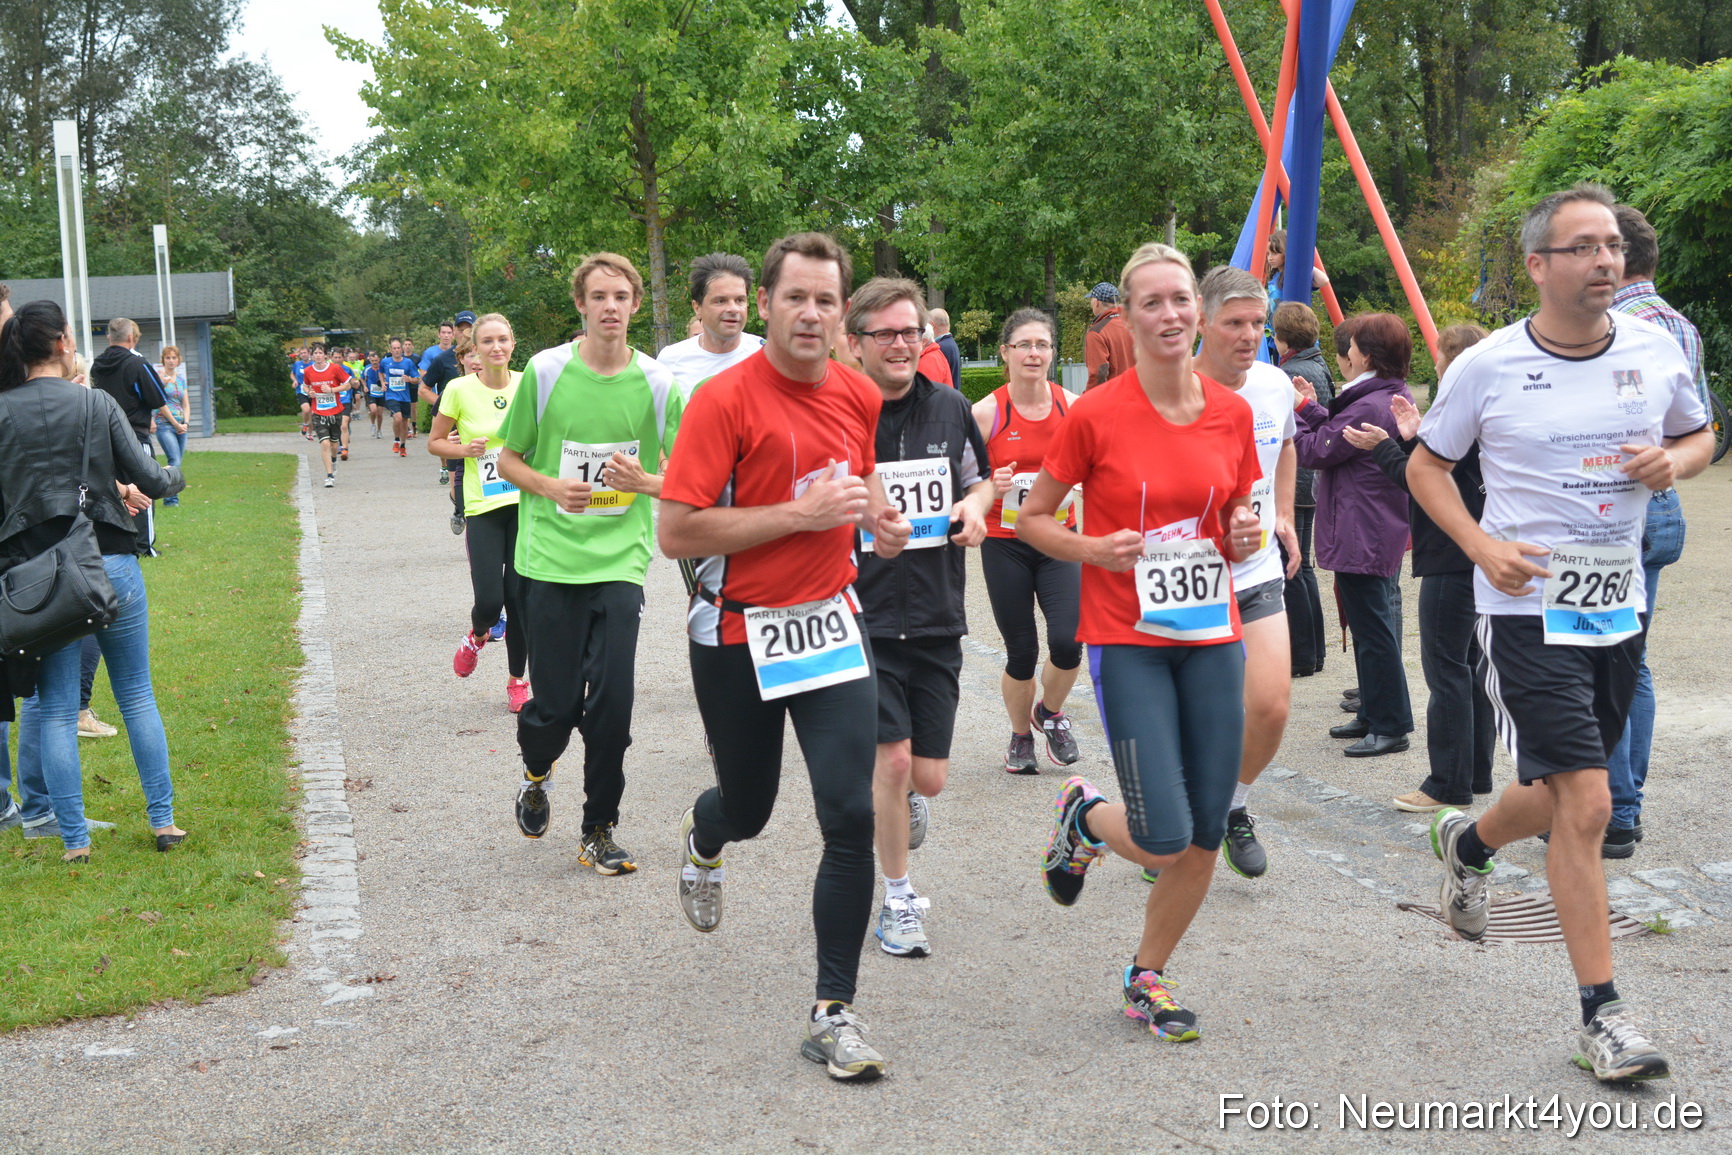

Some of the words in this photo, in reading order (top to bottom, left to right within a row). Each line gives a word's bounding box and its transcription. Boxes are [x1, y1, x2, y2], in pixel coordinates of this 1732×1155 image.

[1548, 431, 1624, 443] Versicherungen
[477, 452, 497, 462] PARTL
[563, 447, 590, 459] PARTL
[1582, 454, 1622, 467] MERZ
[892, 468, 935, 480] Neumarkt
[588, 493, 618, 506] amuel
[889, 480, 944, 515] 319
[1560, 520, 1617, 529] Versicherungen
[1161, 526, 1183, 542] DEHN
[1137, 552, 1172, 563] PARTL
[1173, 548, 1217, 561] Neumarkt
[1552, 552, 1591, 566] PARTL
[1593, 557, 1635, 567] Neumarkt
[1146, 562, 1224, 605] 3367
[1554, 568, 1633, 608] 2260
[747, 610, 784, 620] PARTL
[760, 609, 849, 659] 2009
